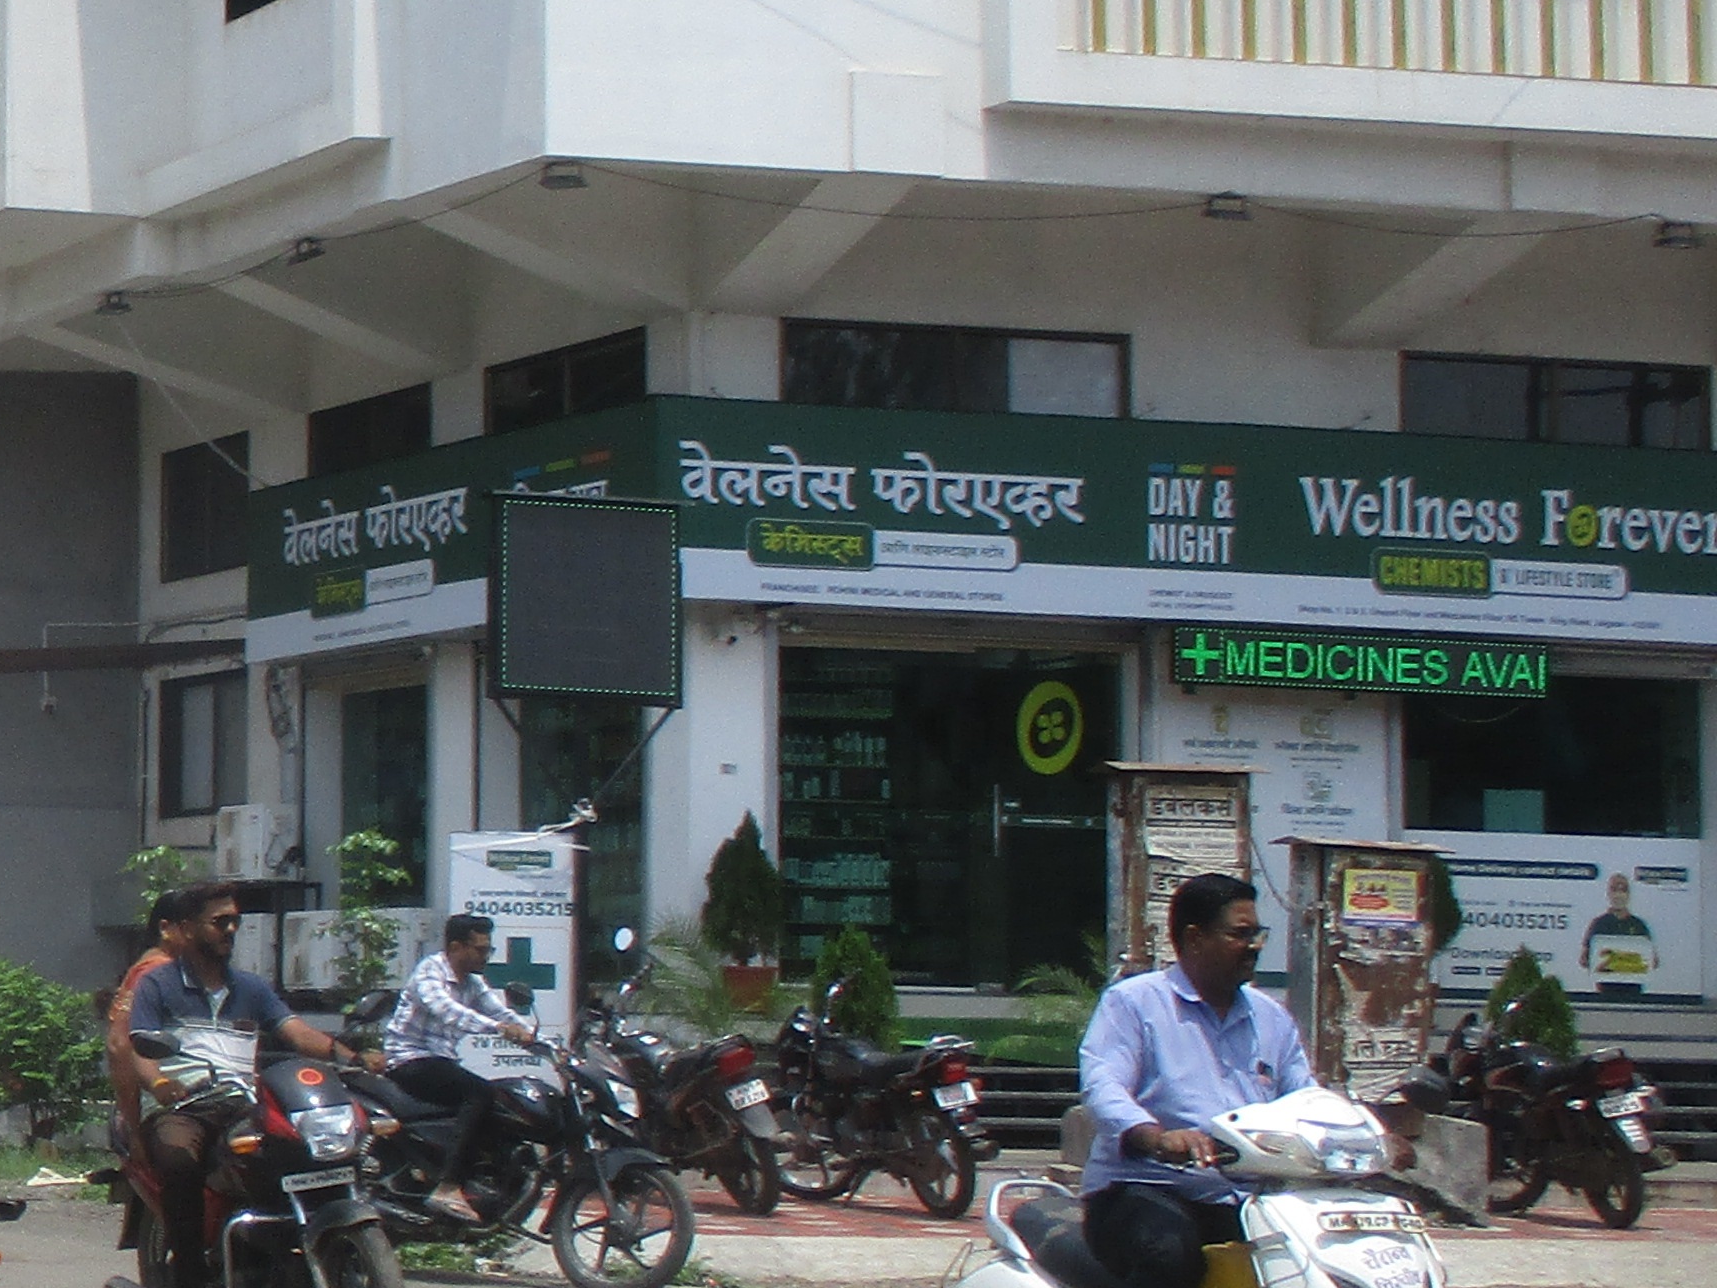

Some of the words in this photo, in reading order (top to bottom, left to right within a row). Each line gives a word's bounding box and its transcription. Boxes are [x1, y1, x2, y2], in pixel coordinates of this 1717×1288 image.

[679, 440, 857, 512] वेलनेस
[870, 452, 1085, 530] फोरएव्हर
[1148, 478, 1201, 517] DAY
[1212, 480, 1235, 519] &
[283, 508, 361, 565] वेलनेस
[365, 484, 469, 552] फोरएव्हर
[1298, 476, 1522, 545] Wellness
[1539, 489, 1717, 555] Forever
[1148, 524, 1235, 565] NIGHT
[1380, 555, 1487, 589] CHEMISTS
[1515, 568, 1573, 586] LIFESTYLE
[1575, 570, 1613, 589] STORE
[1226, 640, 1449, 685] MEDICINES
[1460, 651, 1547, 690] AVAI
[464, 901, 574, 916] 9404035215
[1462, 912, 1569, 930] 404035215
